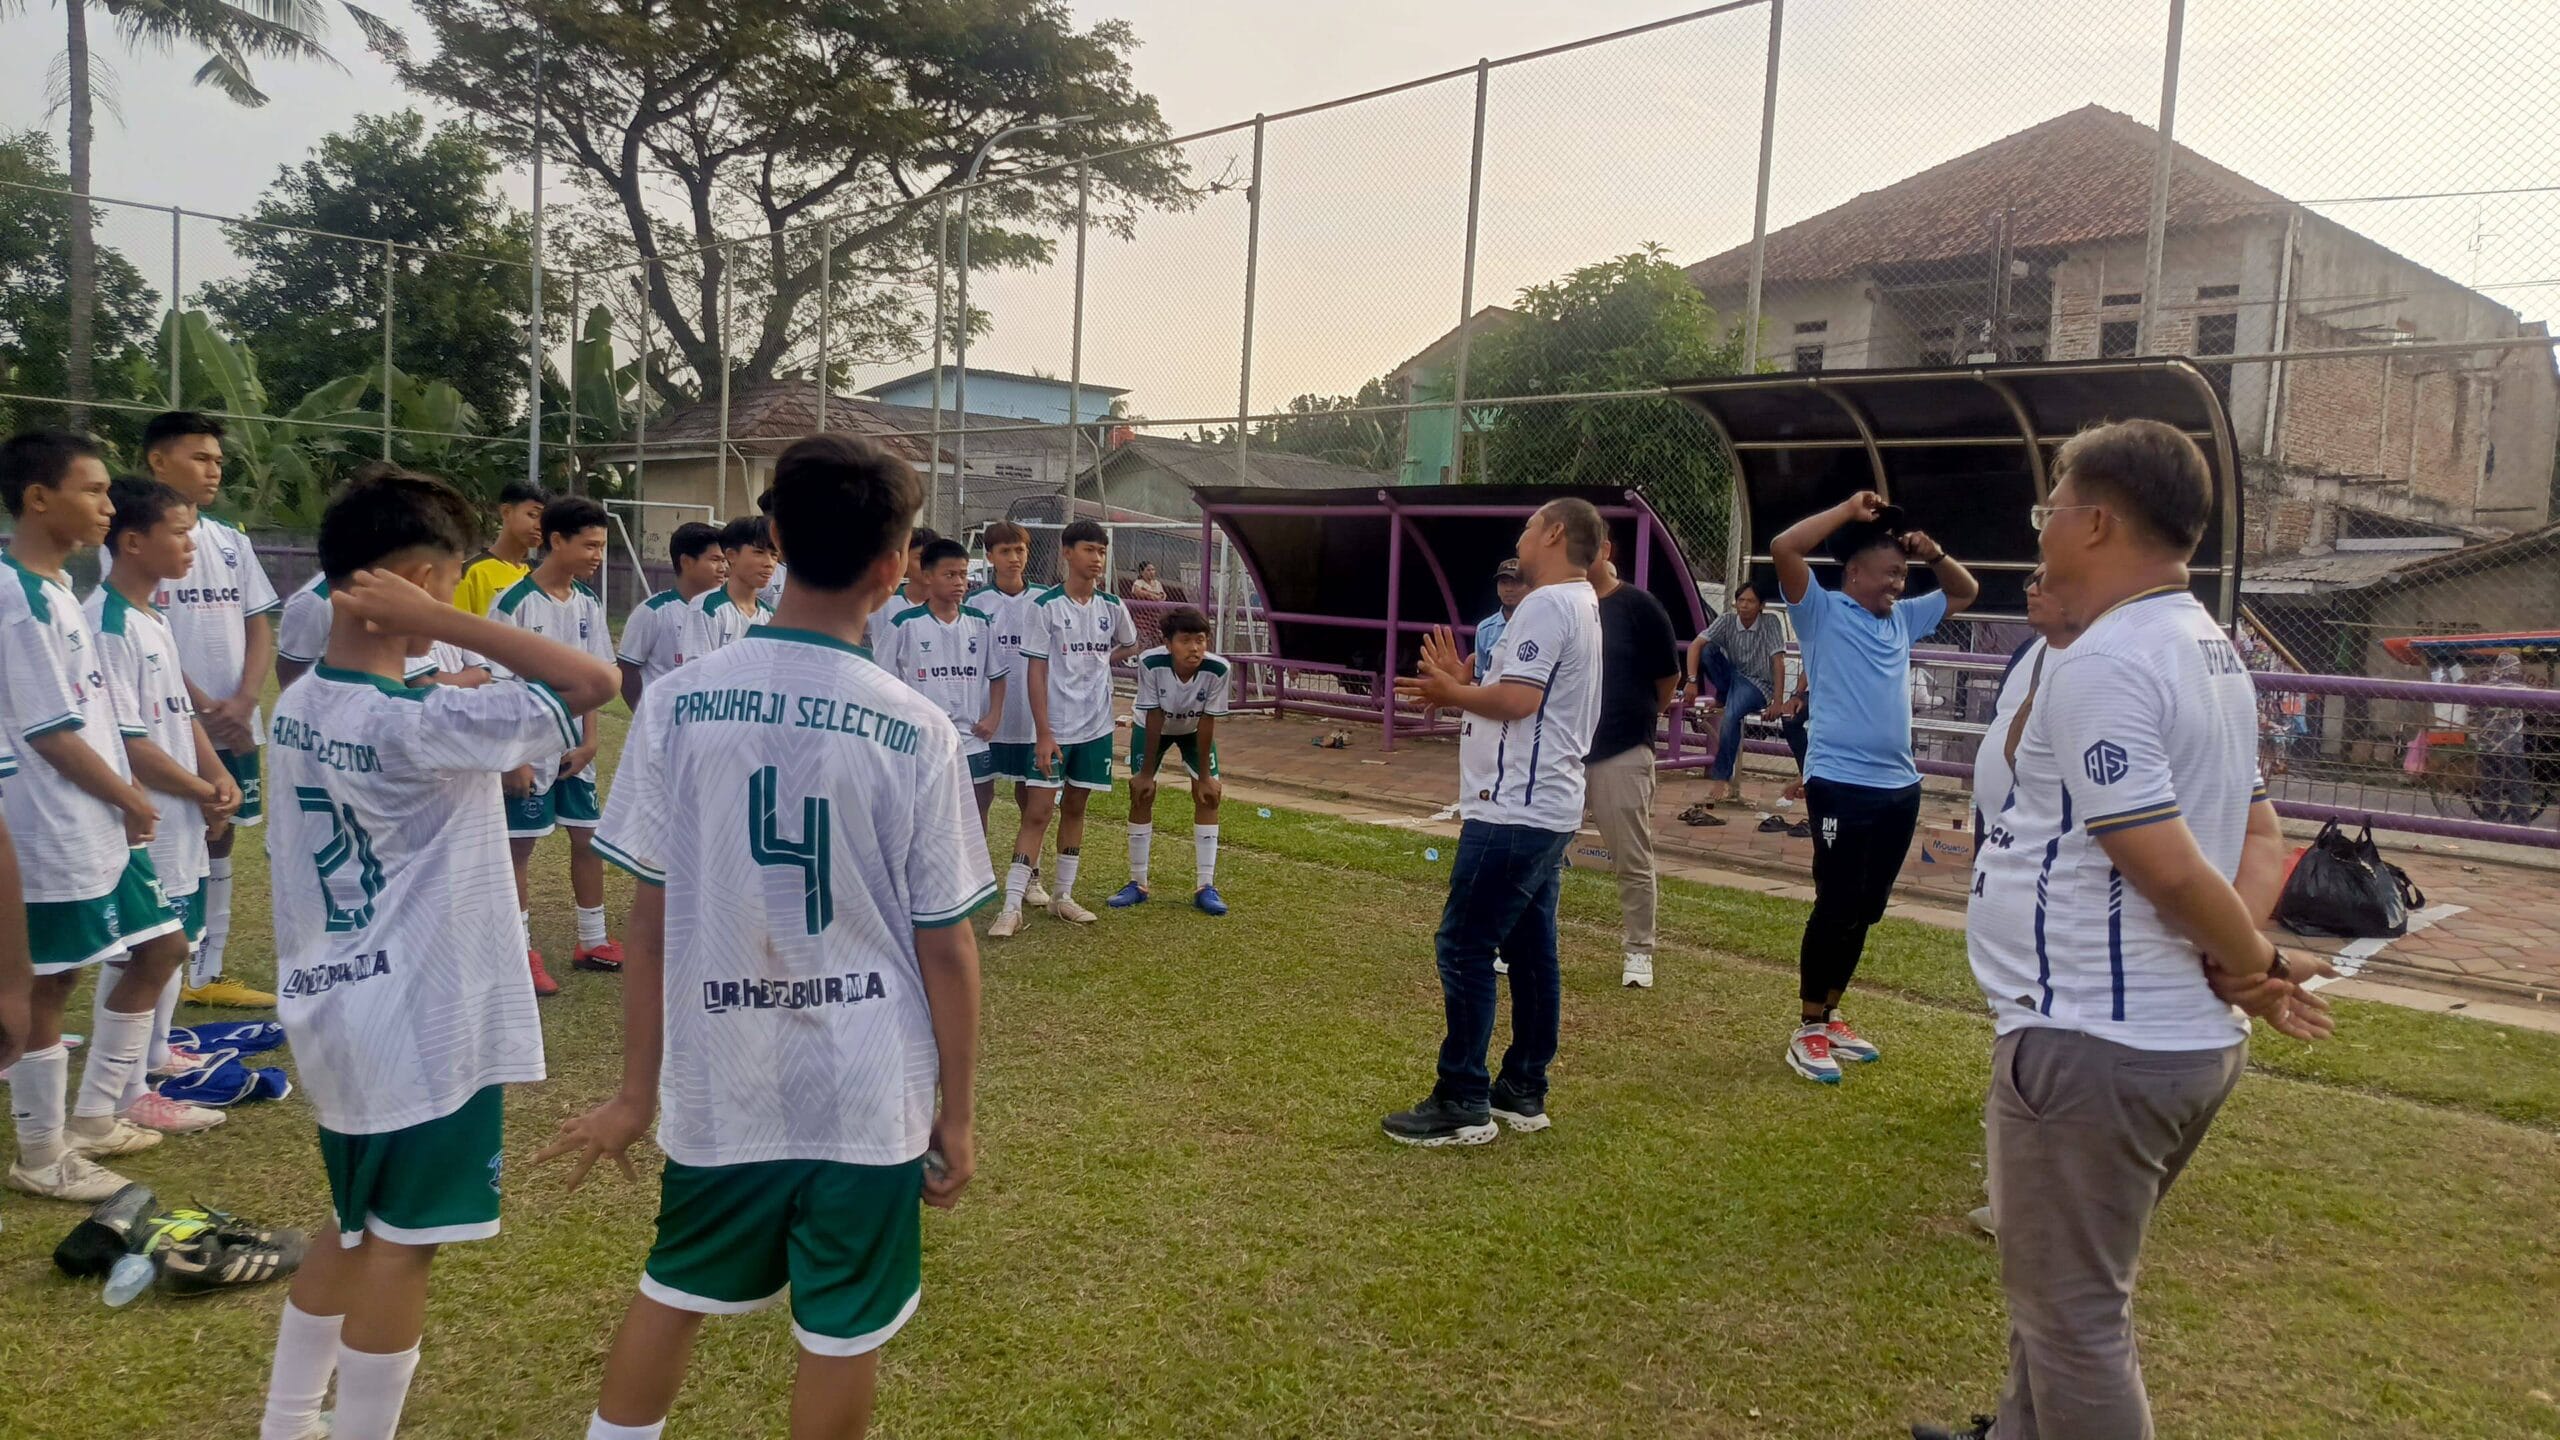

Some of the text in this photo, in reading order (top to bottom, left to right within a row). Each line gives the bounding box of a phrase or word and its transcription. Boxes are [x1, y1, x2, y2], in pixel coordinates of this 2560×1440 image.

[675, 688, 922, 756] PAKUHAJI SELECTION
[295, 785, 387, 933] 21
[748, 765, 835, 936] 4
